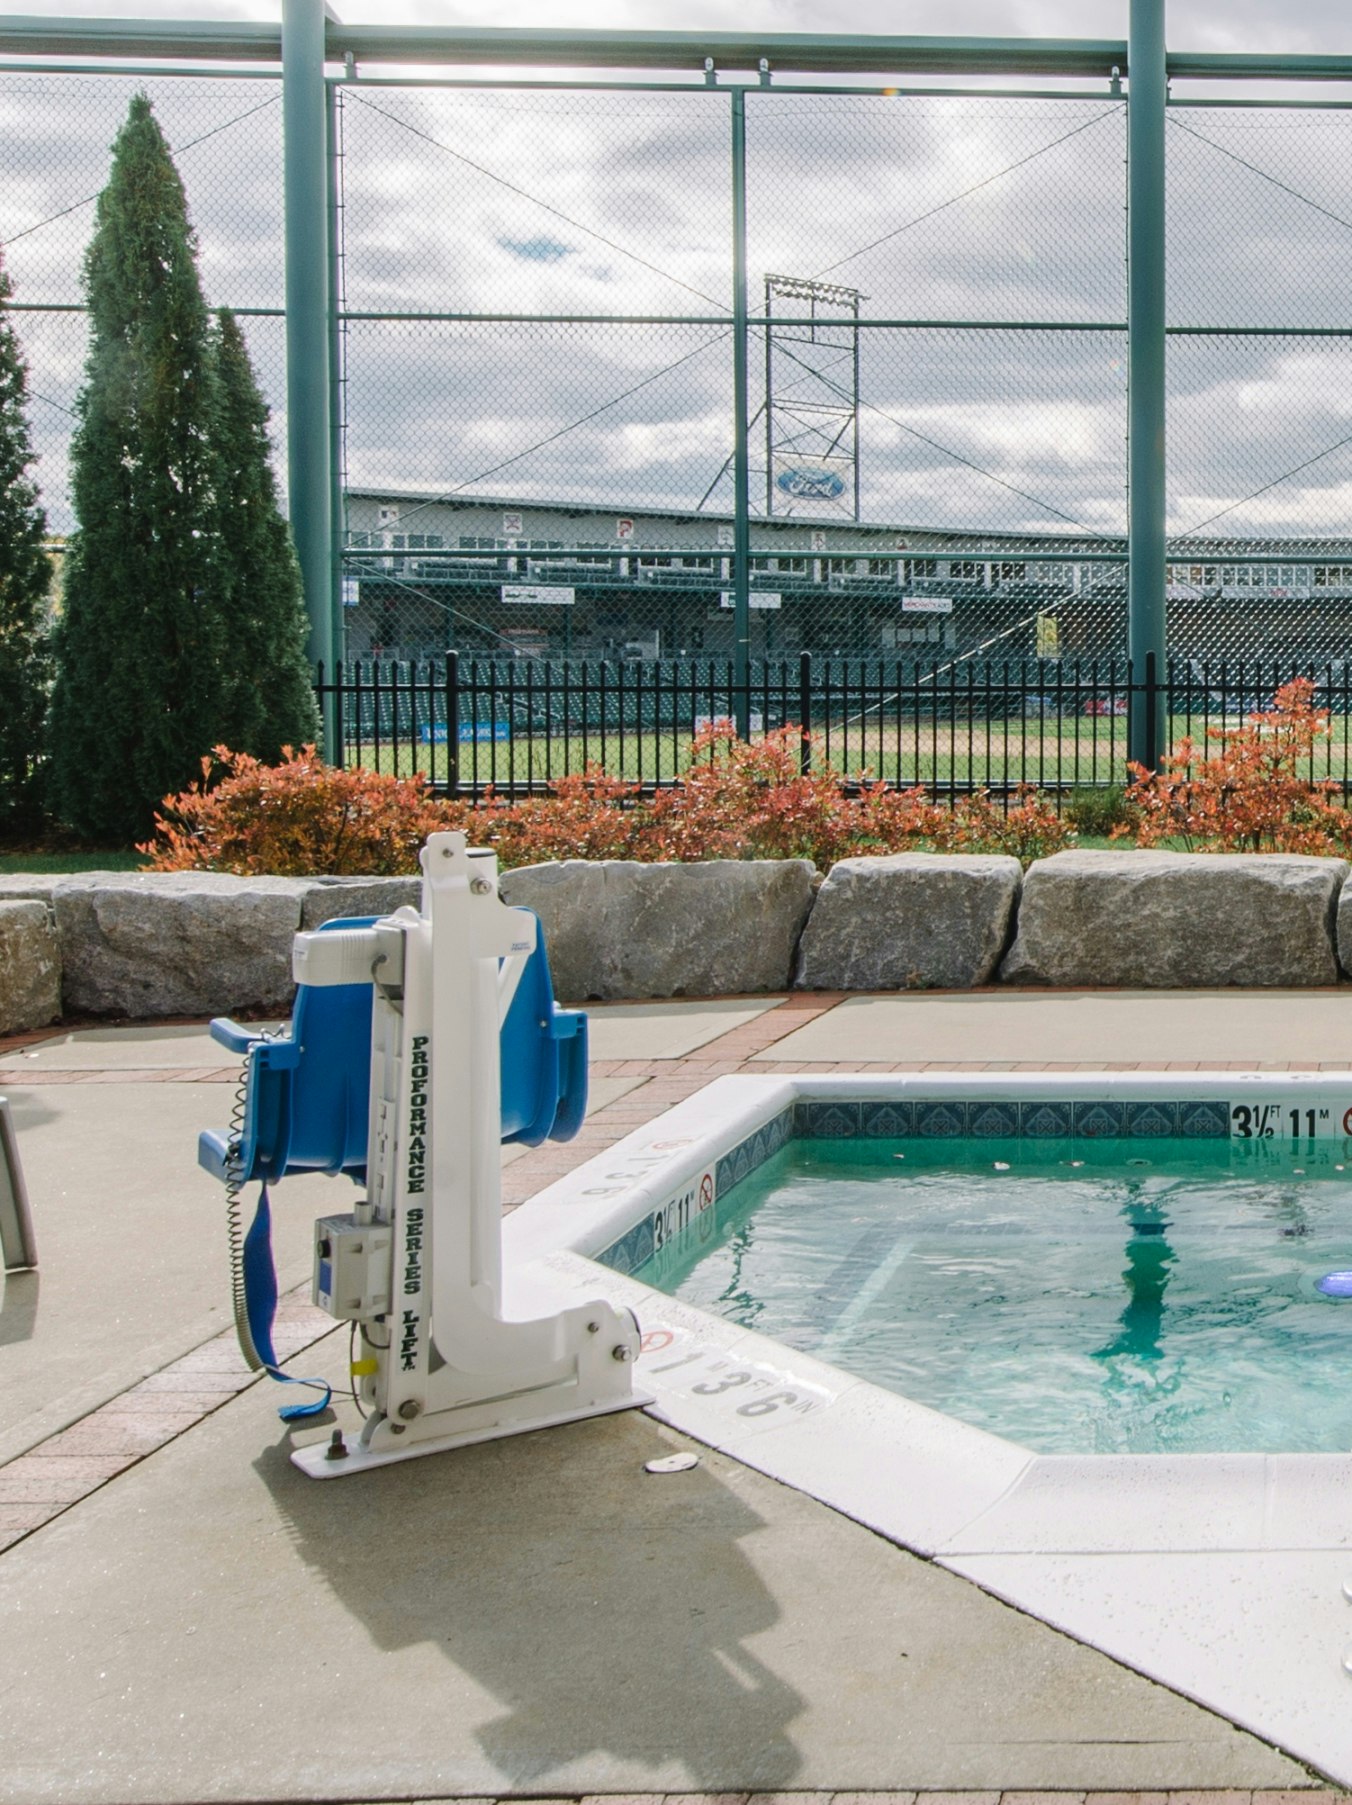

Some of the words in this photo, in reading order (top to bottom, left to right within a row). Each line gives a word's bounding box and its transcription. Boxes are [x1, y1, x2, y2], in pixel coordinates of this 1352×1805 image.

[407, 1036, 429, 1194] PROFORMANCE
[404, 1208, 424, 1294] SERIES
[400, 1310, 419, 1367] LIFT
[692, 1371, 752, 1395] 3
[736, 1391, 798, 1417] 6
